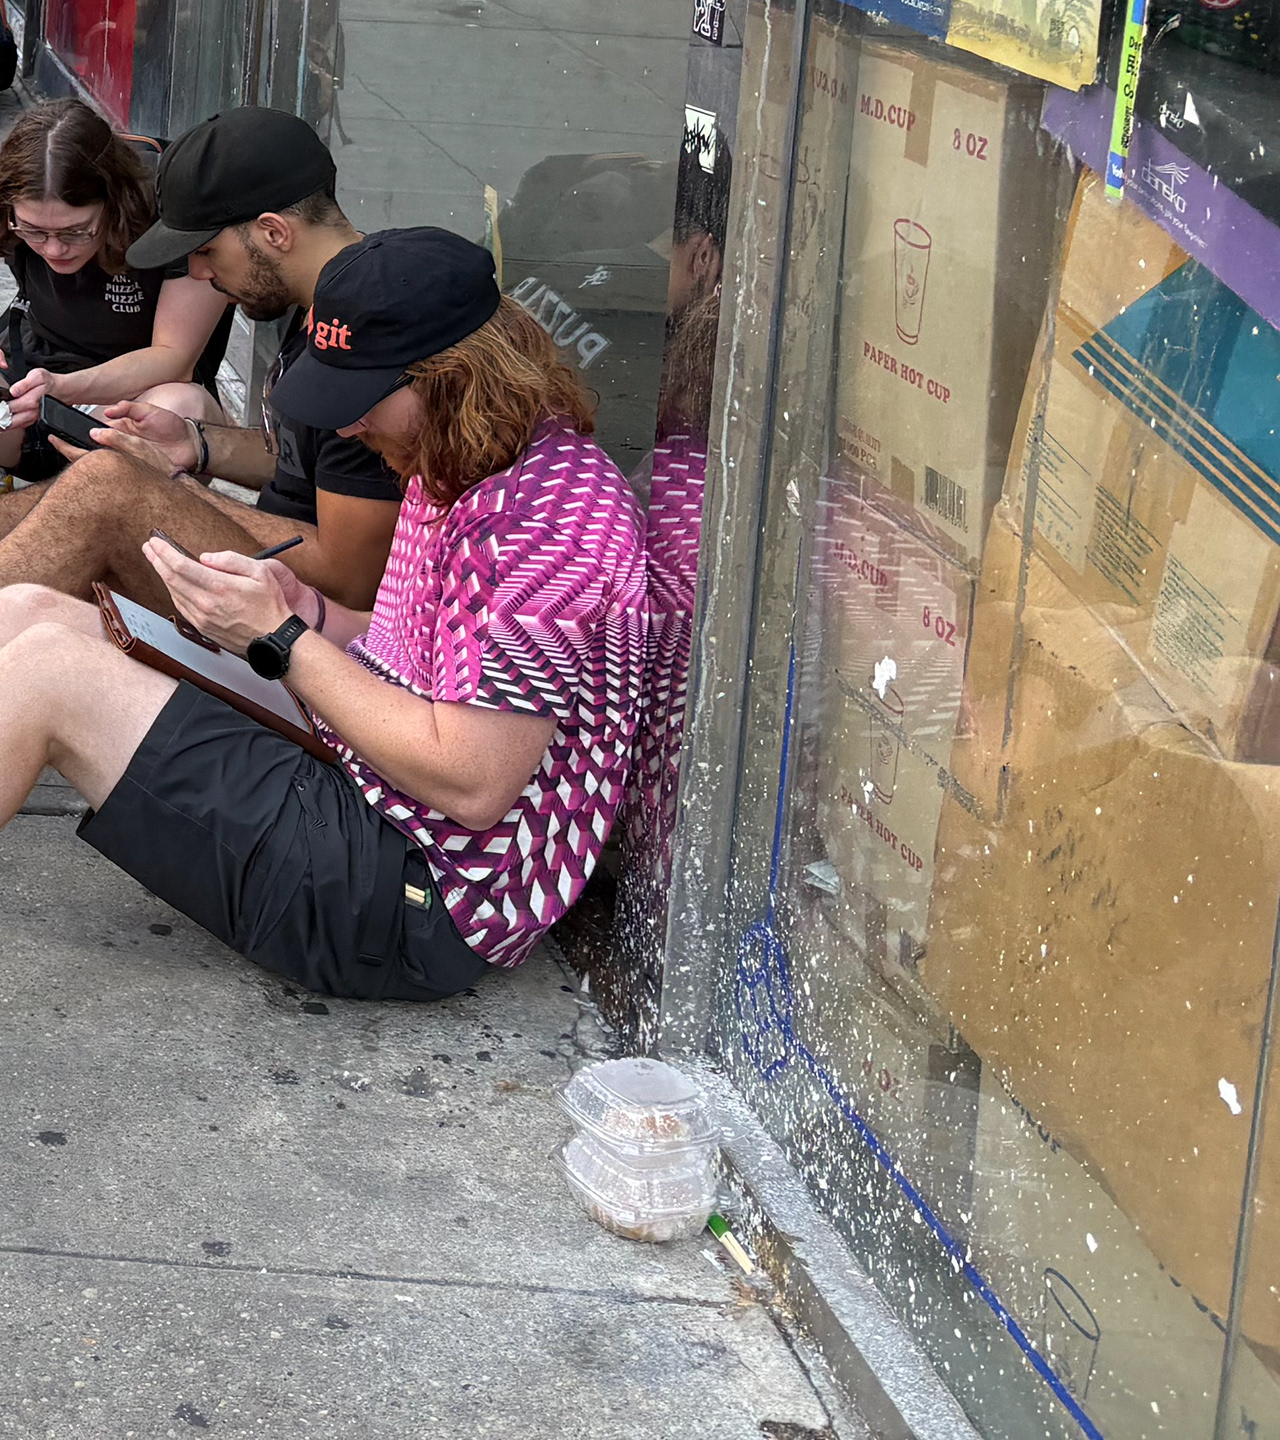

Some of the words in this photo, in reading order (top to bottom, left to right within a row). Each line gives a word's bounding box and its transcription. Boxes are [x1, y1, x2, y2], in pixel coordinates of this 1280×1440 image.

[860, 95, 916, 132] M.D.CUP
[953, 128, 962, 151] 8
[965, 135, 988, 161] OZ
[1142, 160, 1186, 213] dansko
[105, 291, 144, 303] PUZZLE
[315, 317, 351, 351] git
[863, 341, 897, 376] PAPER
[900, 364, 923, 390] HOT
[926, 377, 951, 403] CUP
[922, 606, 930, 627] 8
[935, 616, 956, 647] OZ
[876, 824, 899, 851] HOT
[901, 842, 923, 872] CUP
